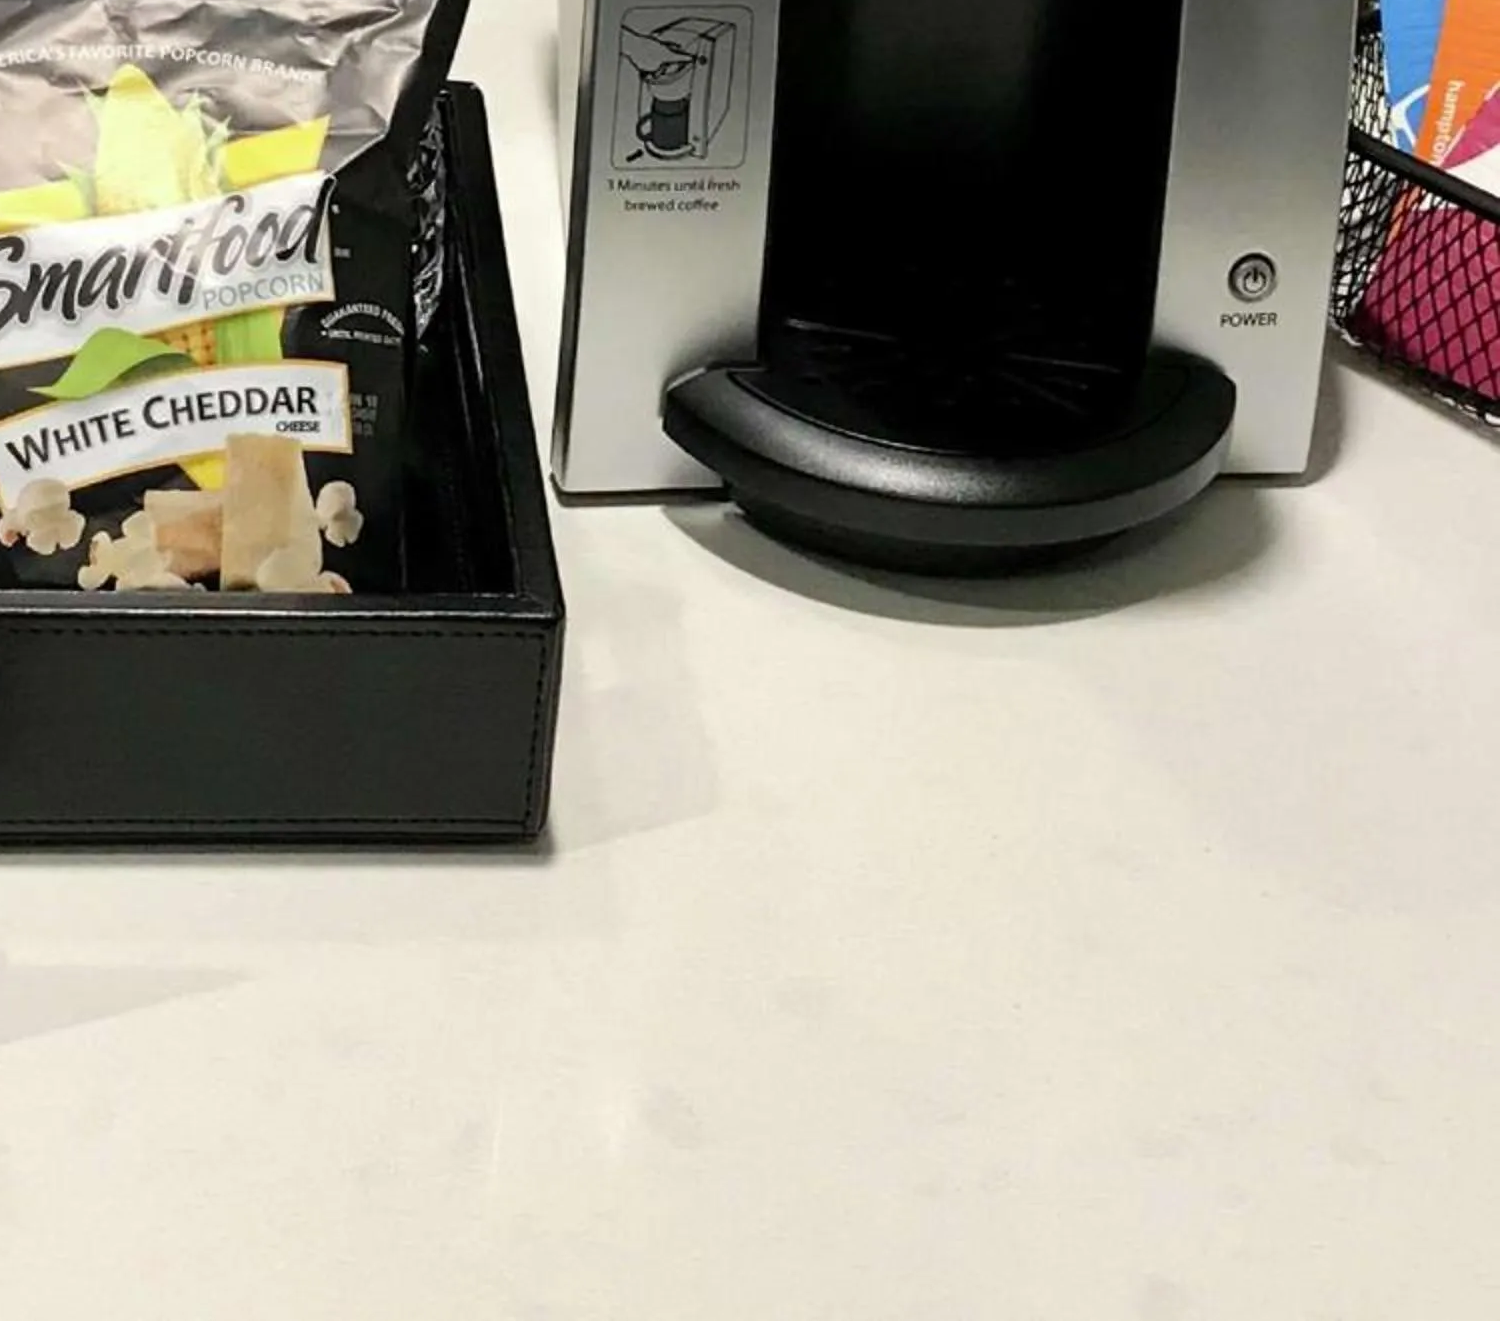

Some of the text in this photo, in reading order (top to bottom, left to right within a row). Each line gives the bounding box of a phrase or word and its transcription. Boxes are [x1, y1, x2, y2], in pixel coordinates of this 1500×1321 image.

[68, 44, 156, 61] FAVORITE
[159, 45, 247, 70] POPCORN
[250, 57, 314, 82] BRAND
[202, 272, 324, 311] POPCORN
[1220, 312, 1278, 328] POWER
[5, 408, 135, 472] WHITE
[142, 386, 318, 430] CHEDDAR
[275, 420, 321, 433] CHEESE
